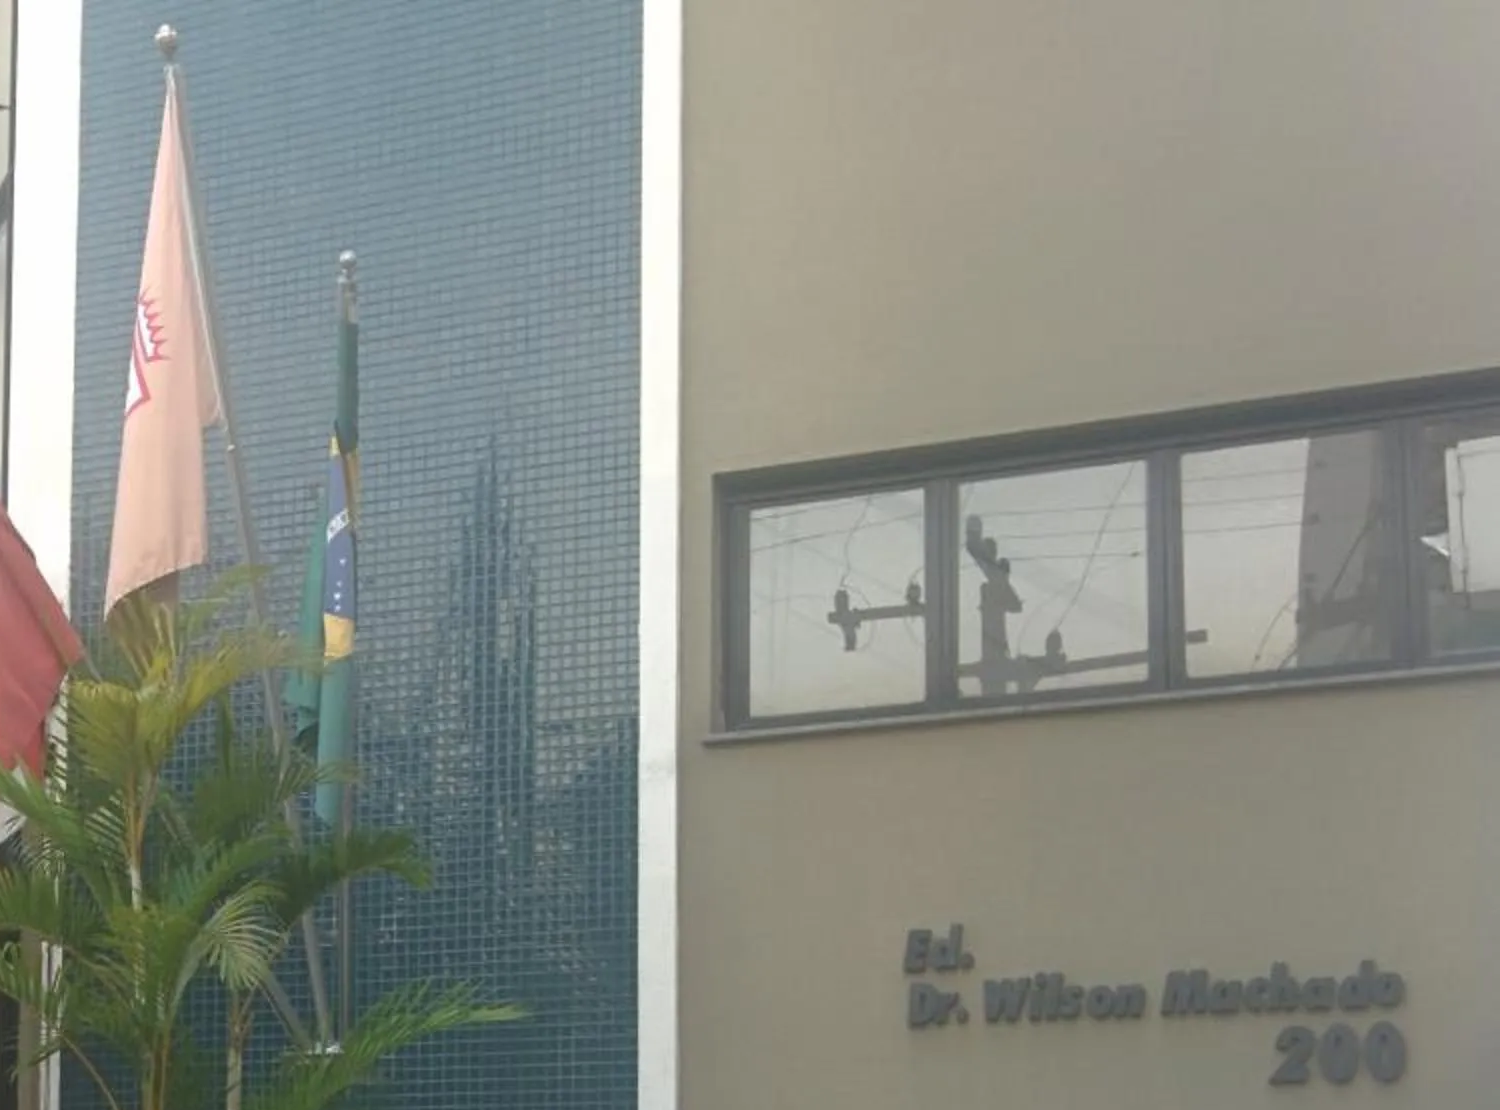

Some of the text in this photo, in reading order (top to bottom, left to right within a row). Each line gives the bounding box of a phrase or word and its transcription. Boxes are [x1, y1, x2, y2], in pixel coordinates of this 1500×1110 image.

[904, 922, 975, 974] Ed.
[908, 958, 1407, 1029] Dr. Wilson Machado
[1268, 1020, 1408, 1086] 200
